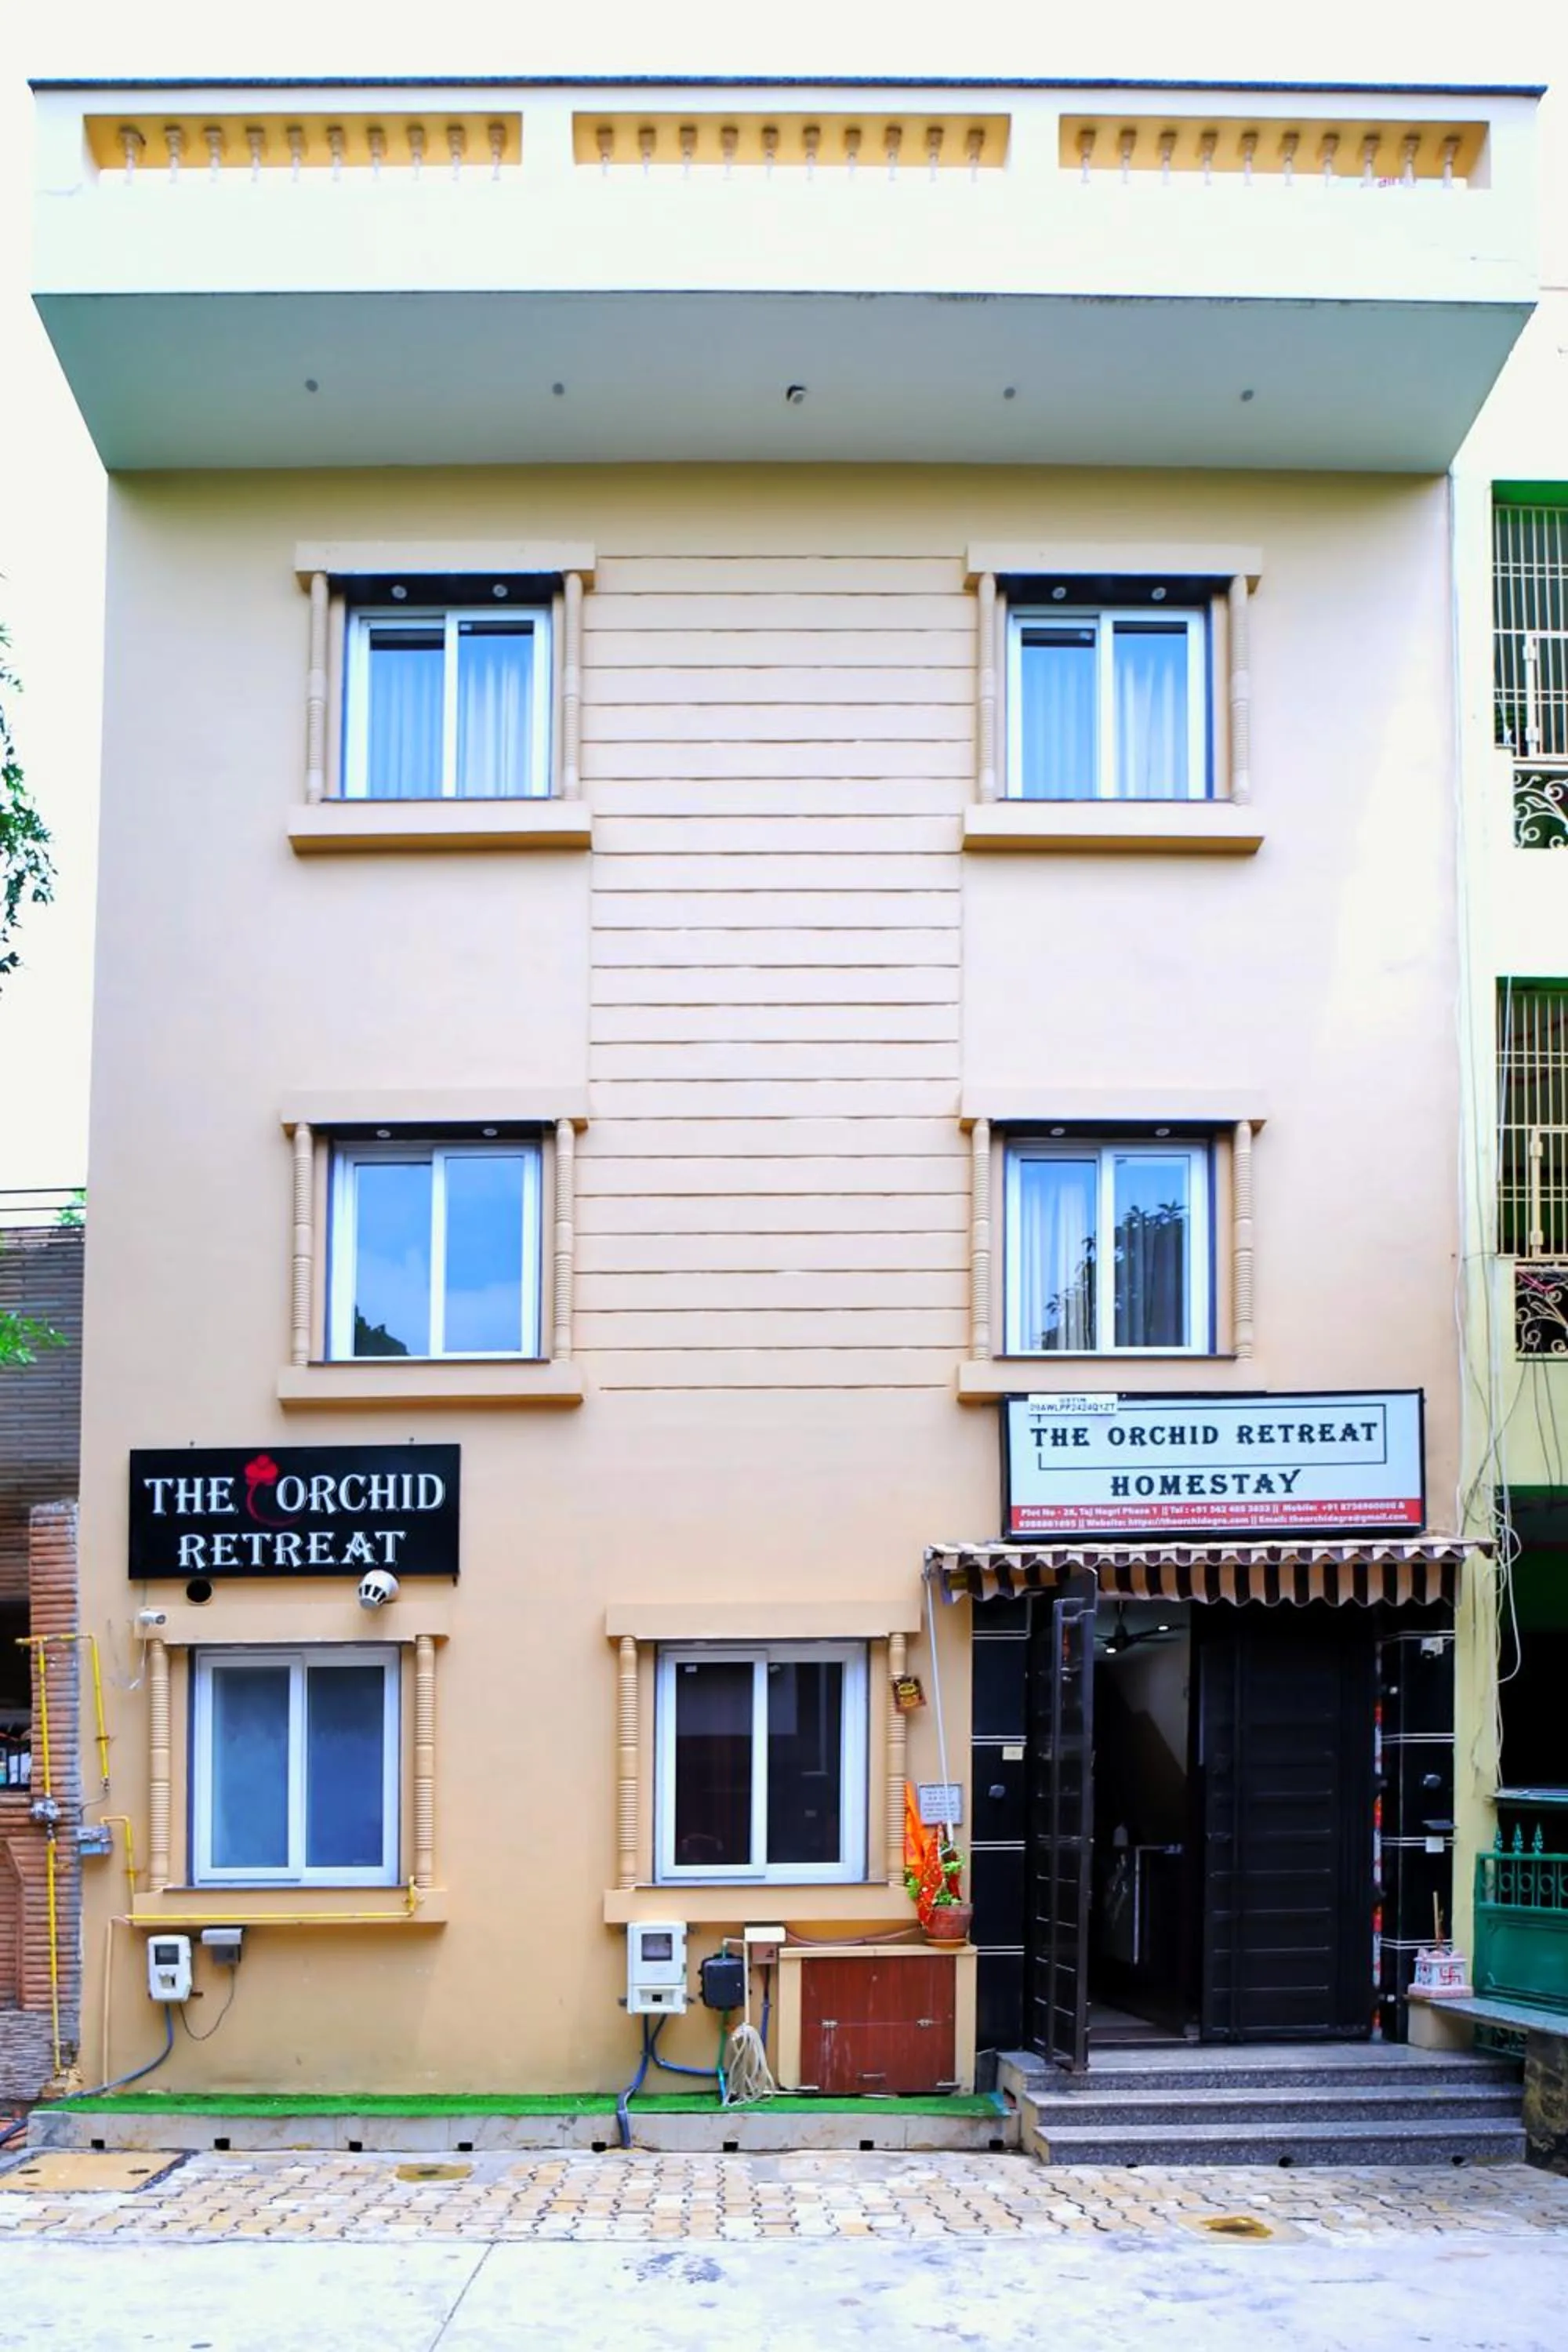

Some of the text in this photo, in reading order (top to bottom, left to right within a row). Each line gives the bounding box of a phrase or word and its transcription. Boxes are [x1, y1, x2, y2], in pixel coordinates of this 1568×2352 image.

[1029, 1421, 1378, 1448] THE ORCHID RETREAT
[143, 1473, 446, 1515] THE ORCHID
[1110, 1468, 1302, 1497] HOMESTAY
[1122, 1506, 1150, 1515] Phase
[177, 1530, 407, 1569] RETREAT
